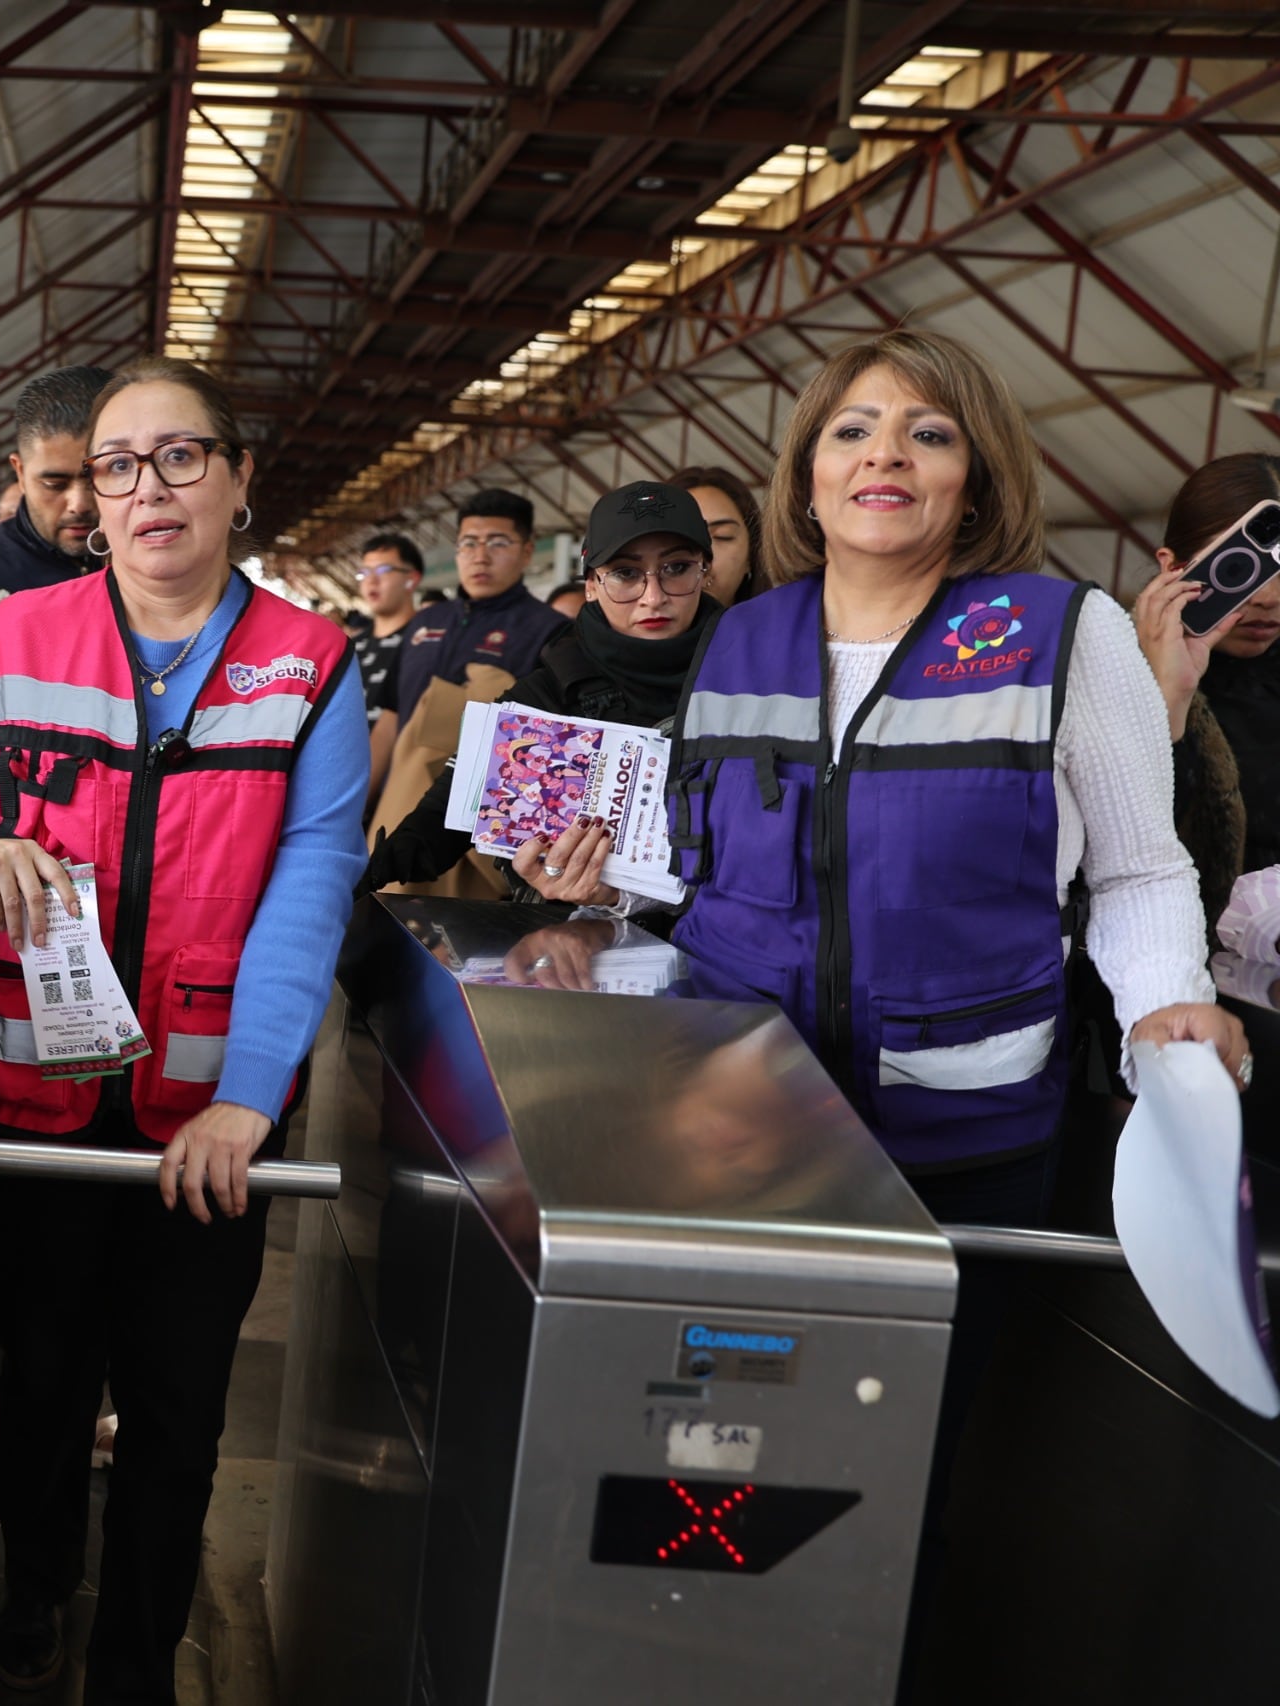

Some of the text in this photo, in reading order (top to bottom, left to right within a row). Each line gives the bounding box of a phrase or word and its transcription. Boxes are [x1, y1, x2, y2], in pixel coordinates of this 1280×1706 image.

[256, 667, 317, 687] SEGURA
[923, 648, 1033, 677] ECATEPEC
[581, 751, 600, 812] RED VIOLETA
[589, 752, 608, 813] ECATEPEC
[47, 1044, 95, 1056] MUJERES
[686, 1324, 796, 1354] GUNNEBO
